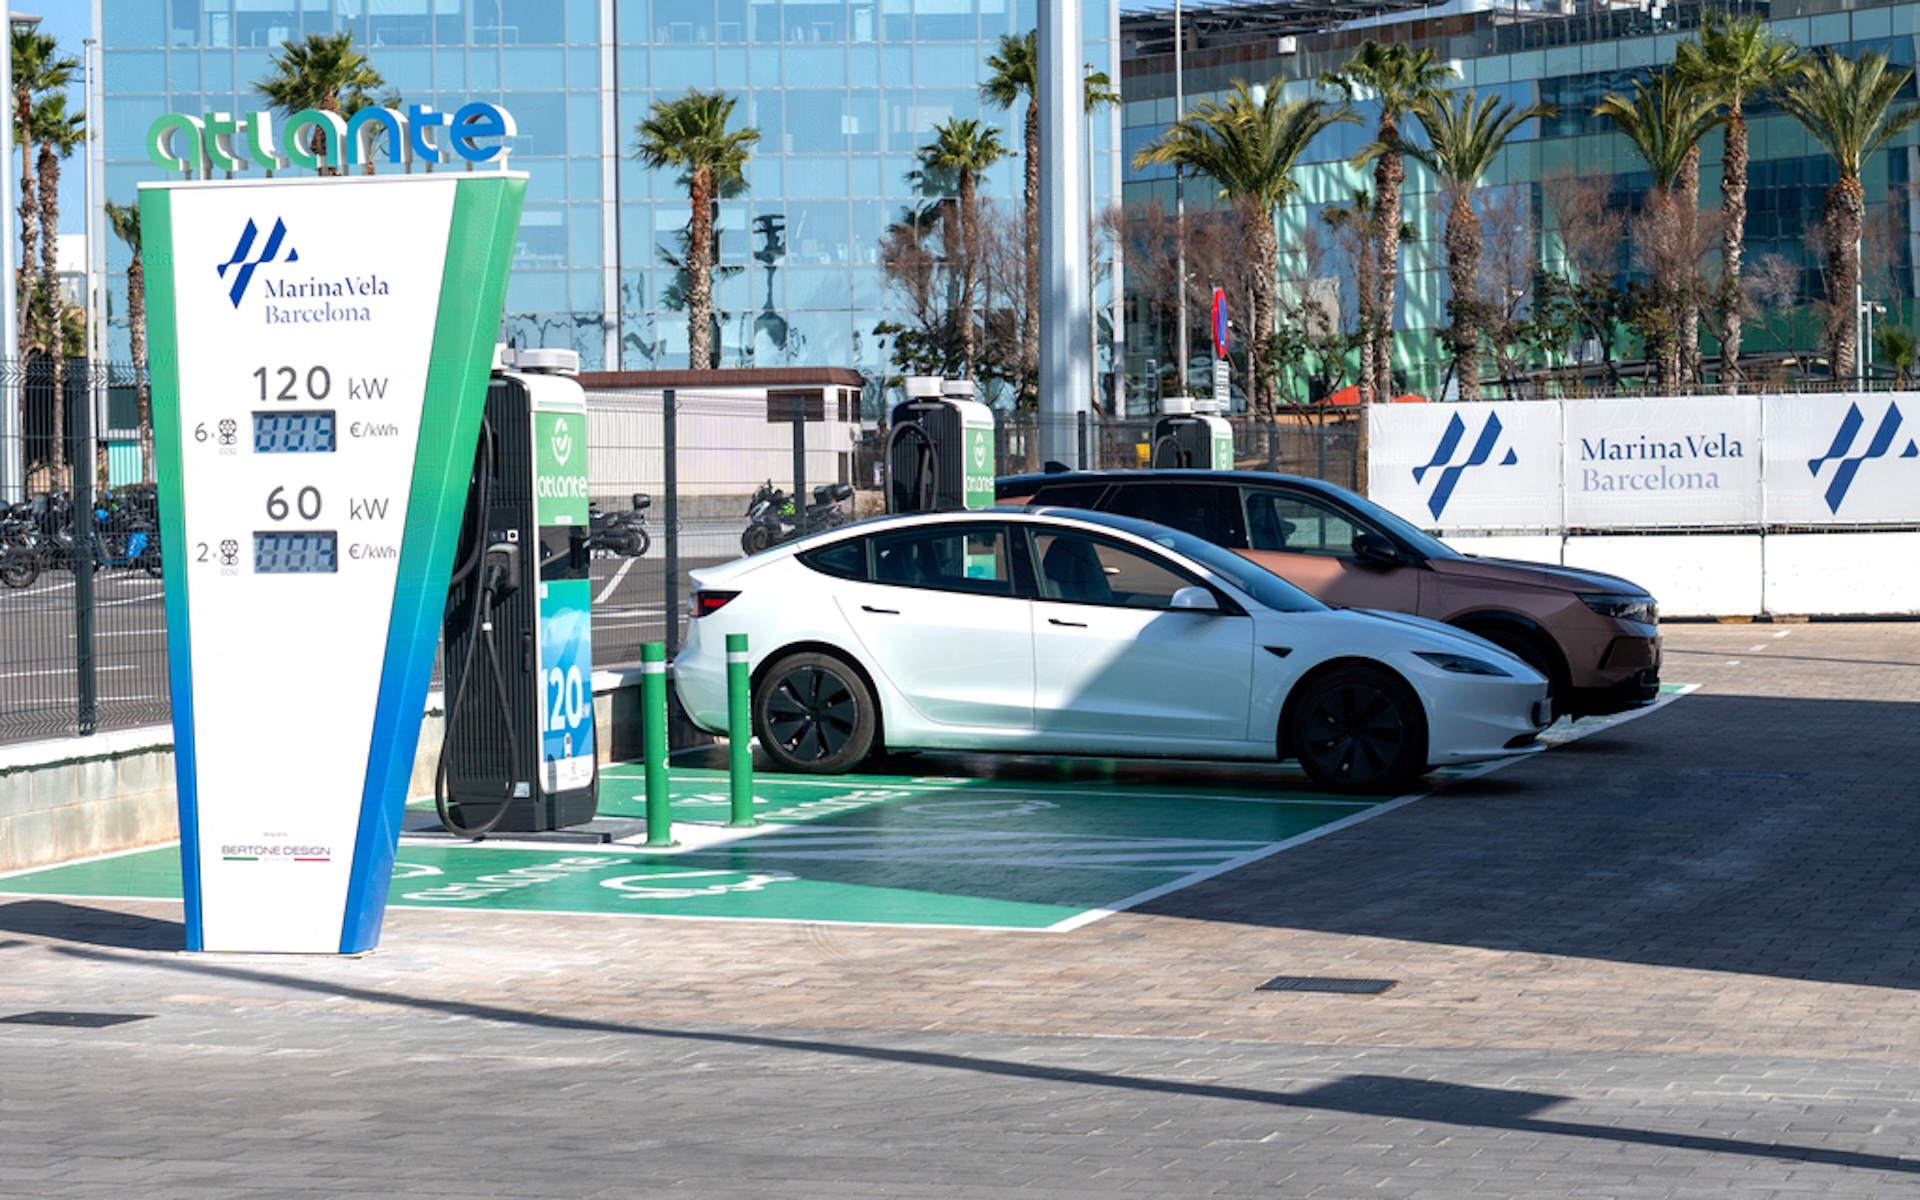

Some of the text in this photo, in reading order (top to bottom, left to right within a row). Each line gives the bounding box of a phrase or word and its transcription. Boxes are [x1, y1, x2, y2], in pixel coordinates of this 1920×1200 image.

[146, 102, 512, 172] atlante
[265, 301, 371, 324] Barcelona
[253, 365, 389, 401] 120 kW
[349, 420, 399, 438] €/kWh
[538, 475, 588, 498] atlante
[1582, 464, 1720, 491] Barcelona
[266, 485, 389, 521] 60 kW
[349, 543, 397, 560] €/kWh
[541, 665, 584, 732] 120
[221, 845, 331, 856] BERTONE DESIGN
